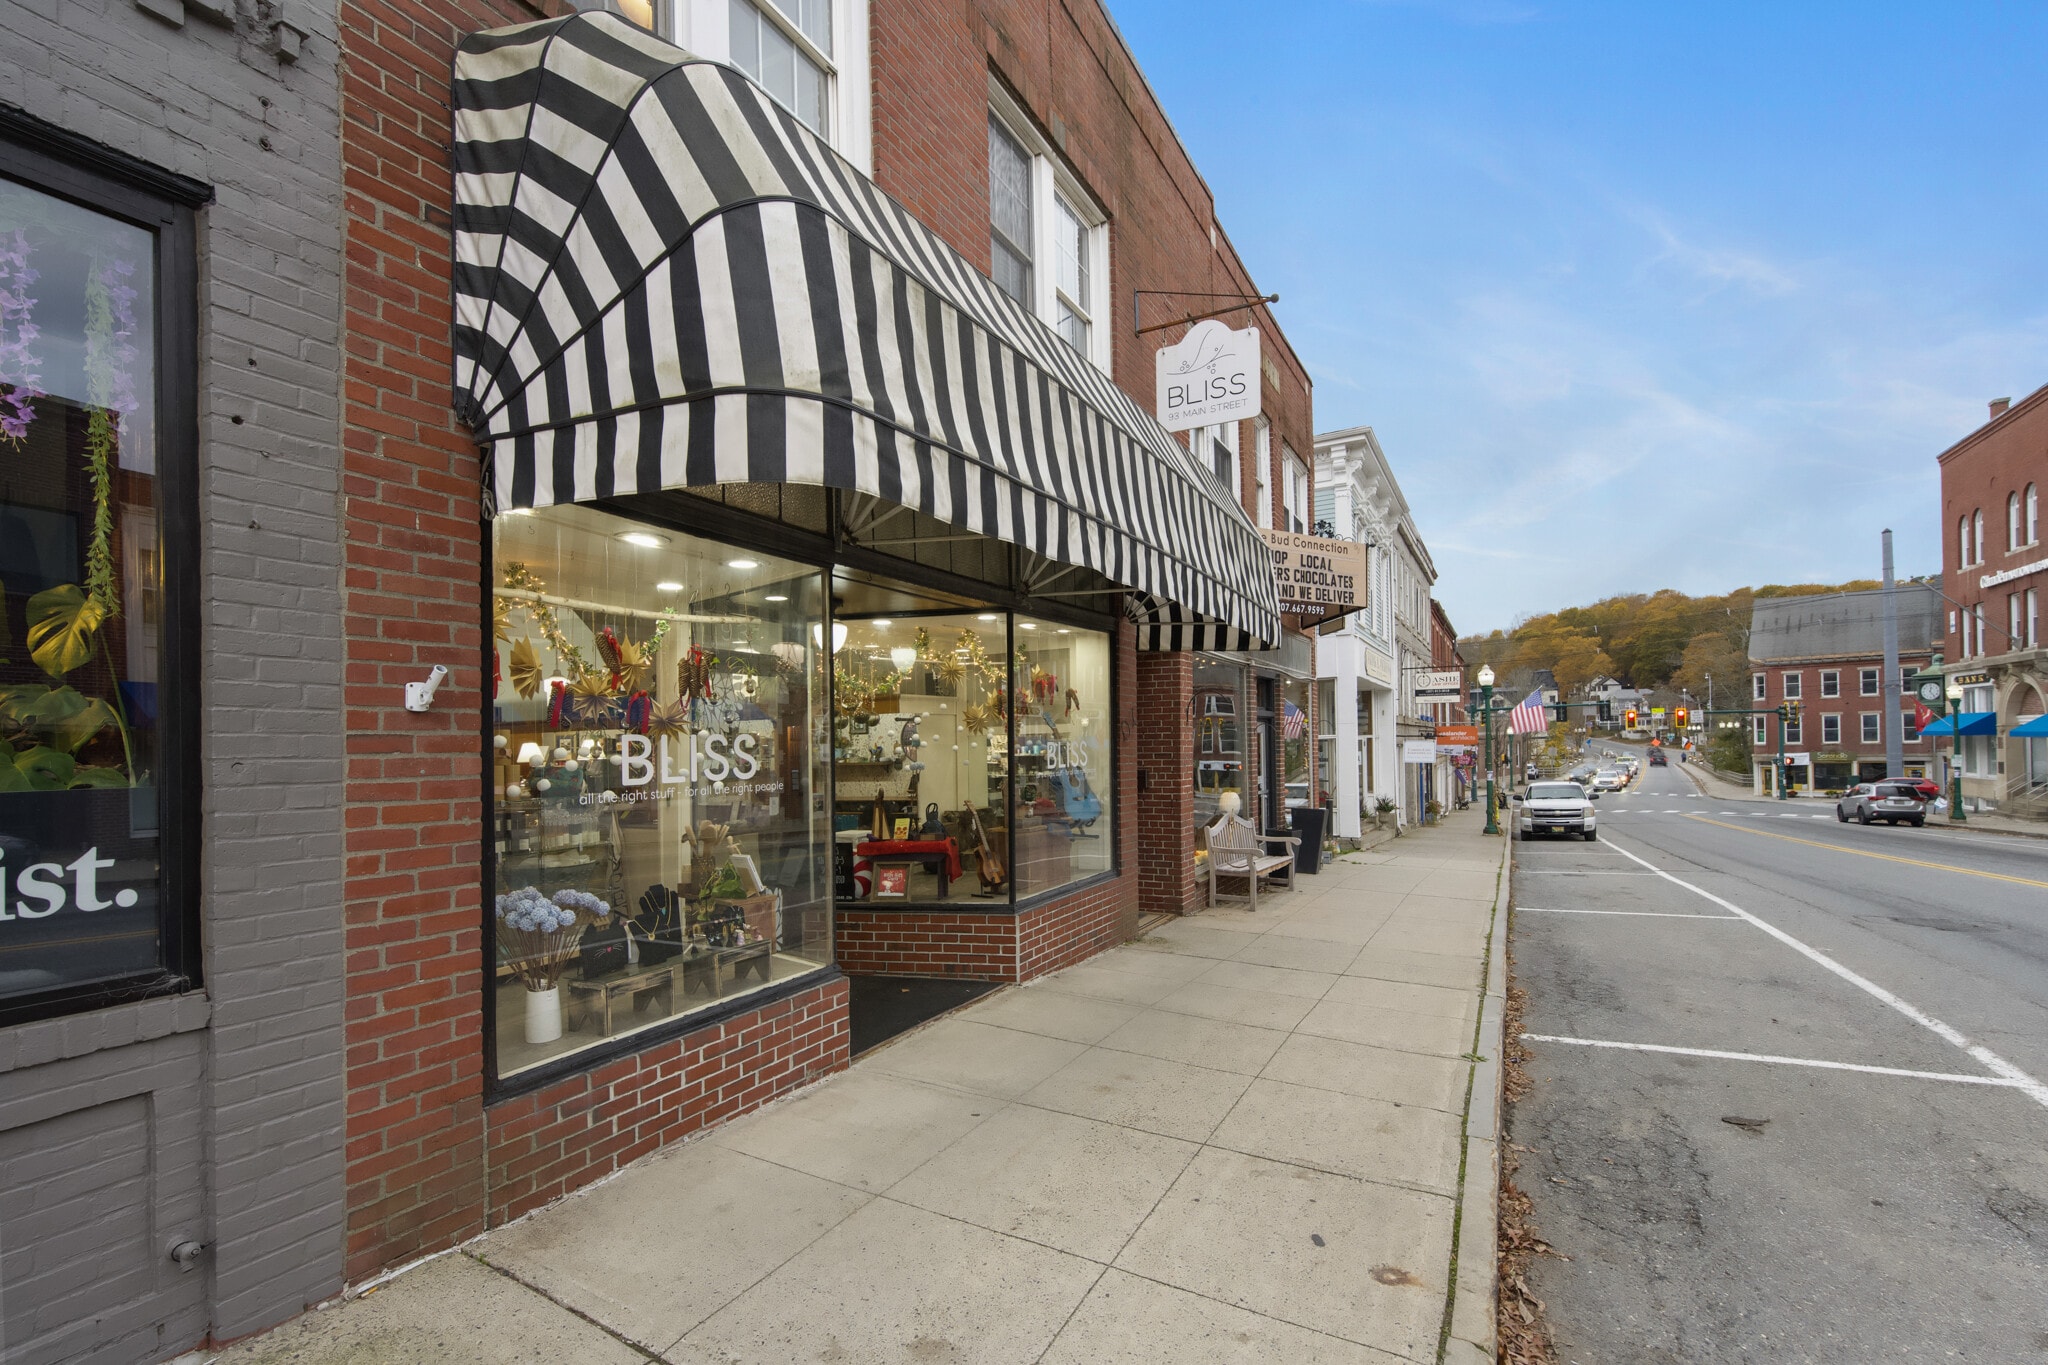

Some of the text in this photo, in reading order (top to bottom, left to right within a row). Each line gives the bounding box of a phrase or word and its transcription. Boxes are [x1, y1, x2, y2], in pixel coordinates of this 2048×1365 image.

[1168, 372, 1246, 408] BLISS
[1168, 398, 1248, 421] 93 MAIN STREET
[1271, 533, 1290, 546] Bud
[1293, 536, 1349, 554] Connection
[1300, 553, 1333, 573] LOCAL
[1293, 569, 1354, 589] CHOCOLATES
[1298, 585, 1312, 600] WE
[1315, 587, 1355, 605] DELIVER
[1957, 674, 1984, 684] BANK
[621, 733, 757, 787] BLISS
[1046, 740, 1088, 769] BLISS
[579, 792, 594, 805] all
[598, 794, 618, 804] the
[621, 789, 648, 805] right
[650, 787, 675, 800] stuff
[684, 786, 698, 797] for
[700, 784, 712, 796] all
[714, 785, 730, 795] the
[732, 783, 753, 796] right
[755, 781, 784, 794] people
